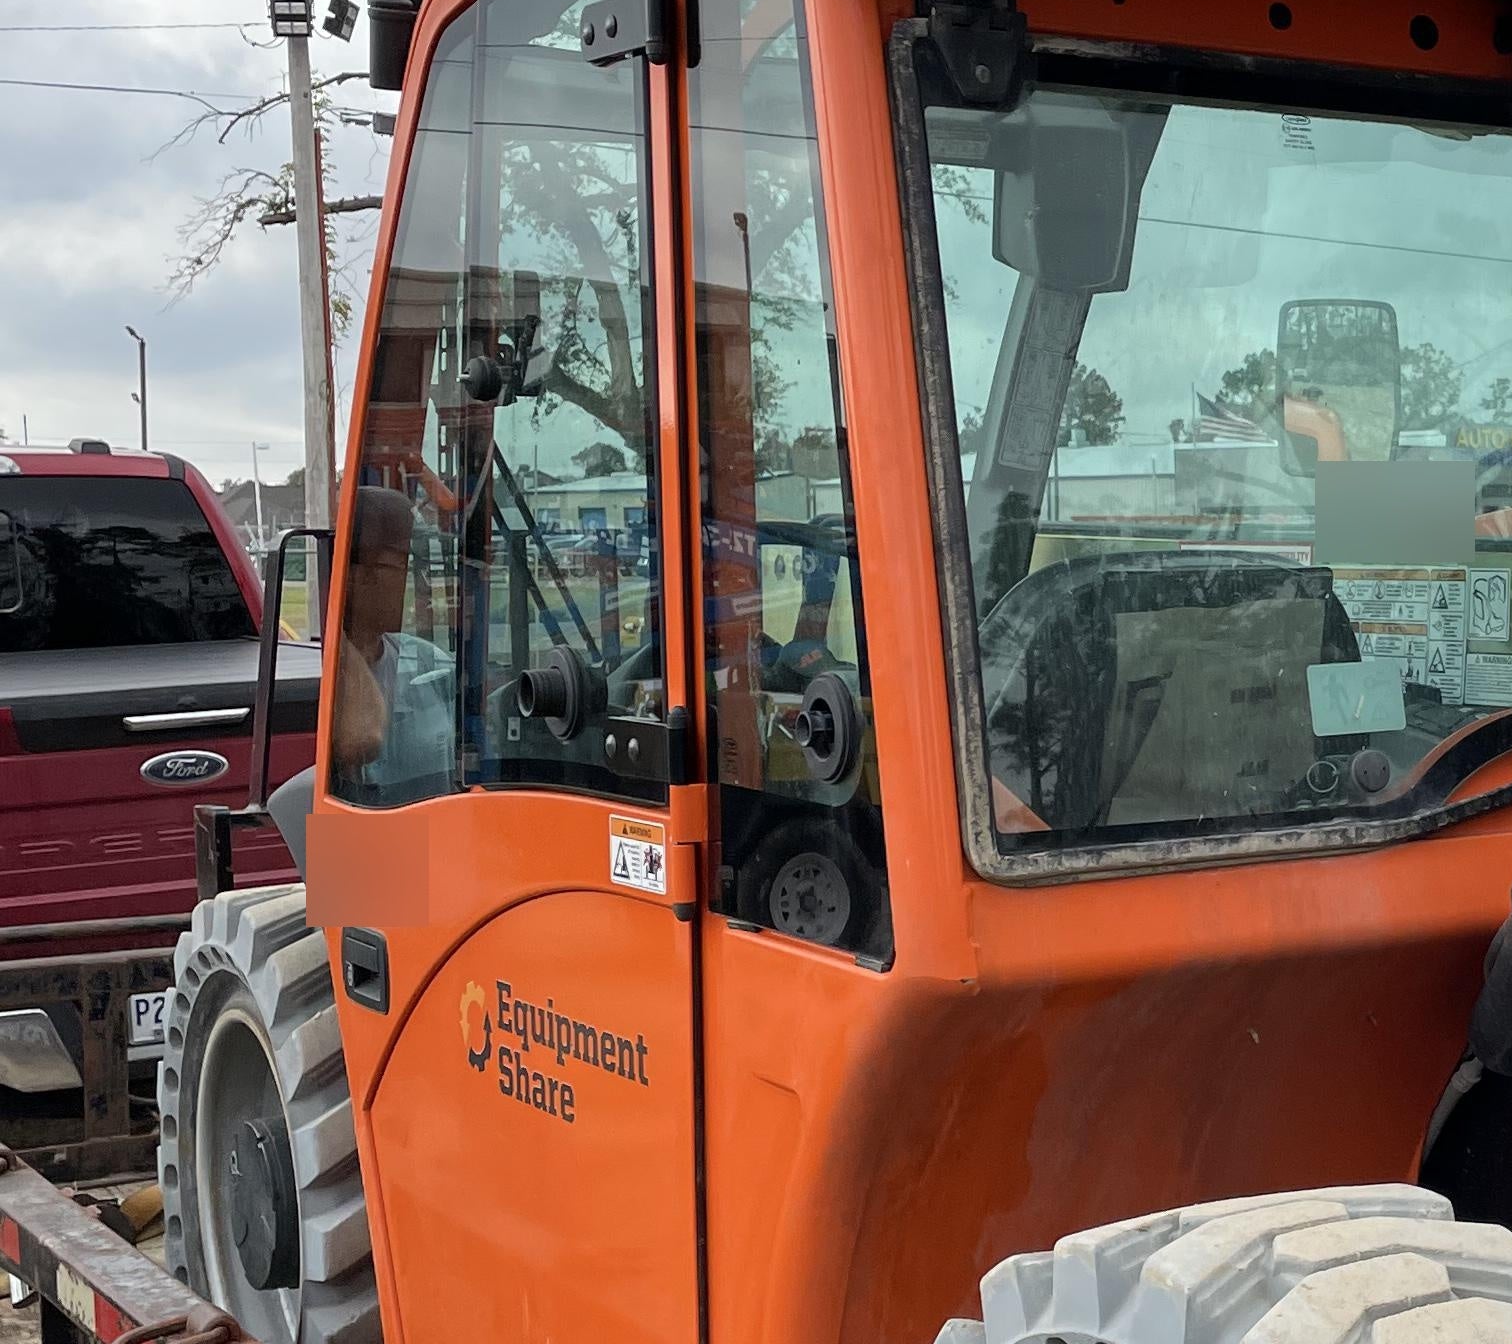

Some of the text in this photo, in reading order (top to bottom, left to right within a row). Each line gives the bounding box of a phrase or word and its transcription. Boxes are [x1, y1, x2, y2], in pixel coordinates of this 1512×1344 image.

[1456, 427, 1506, 449] AUTO
[163, 758, 209, 777] Ford
[496, 979, 650, 1087] Equipment
[498, 1046, 576, 1124] Share
